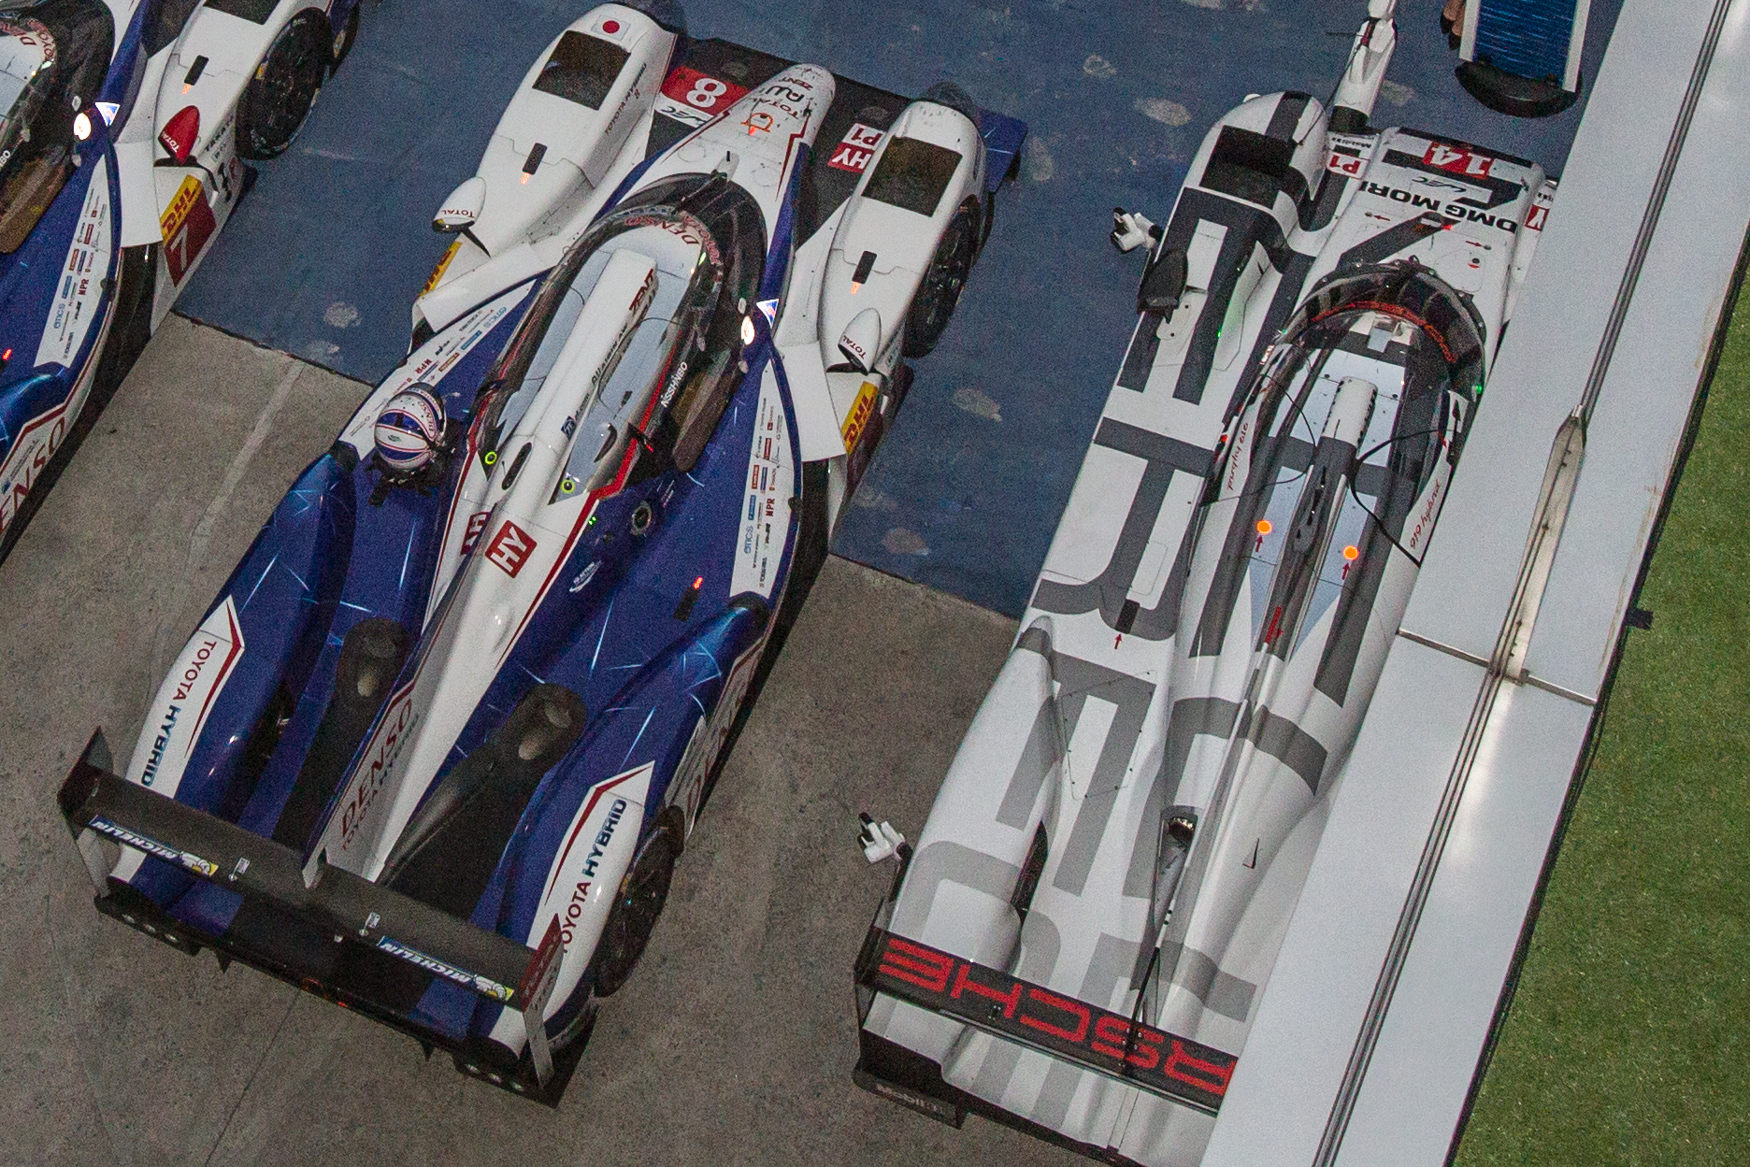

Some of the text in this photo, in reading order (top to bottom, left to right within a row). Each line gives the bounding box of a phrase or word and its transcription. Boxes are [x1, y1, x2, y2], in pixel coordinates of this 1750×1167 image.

[686, 77, 727, 109] 8
[752, 97, 800, 119] TOTAL
[605, 102, 631, 135] TOYOTA
[851, 127, 883, 144] P1
[162, 132, 181, 153] TOTAL
[832, 147, 873, 170] HY
[1429, 145, 1490, 175] 14
[1330, 155, 1362, 175] P1
[162, 187, 197, 234] DHL
[440, 209, 475, 219] TOTAL
[1359, 180, 1518, 234] DMG MORI
[170, 224, 188, 272] 7
[842, 335, 868, 360] TOTAL
[844, 394, 878, 446] DHL
[765, 498, 776, 517] NPR
[1410, 480, 1441, 548] 919 hybrid
[490, 526, 529, 573] HY
[140, 639, 218, 787] TOYOTA HYBRID
[341, 698, 413, 839] DENSO
[94, 820, 179, 861] MICHELIN
[560, 798, 627, 954] OYOTA HYBRID
[381, 942, 473, 984] MICHELIN
[878, 938, 1237, 1095] RSCHE
